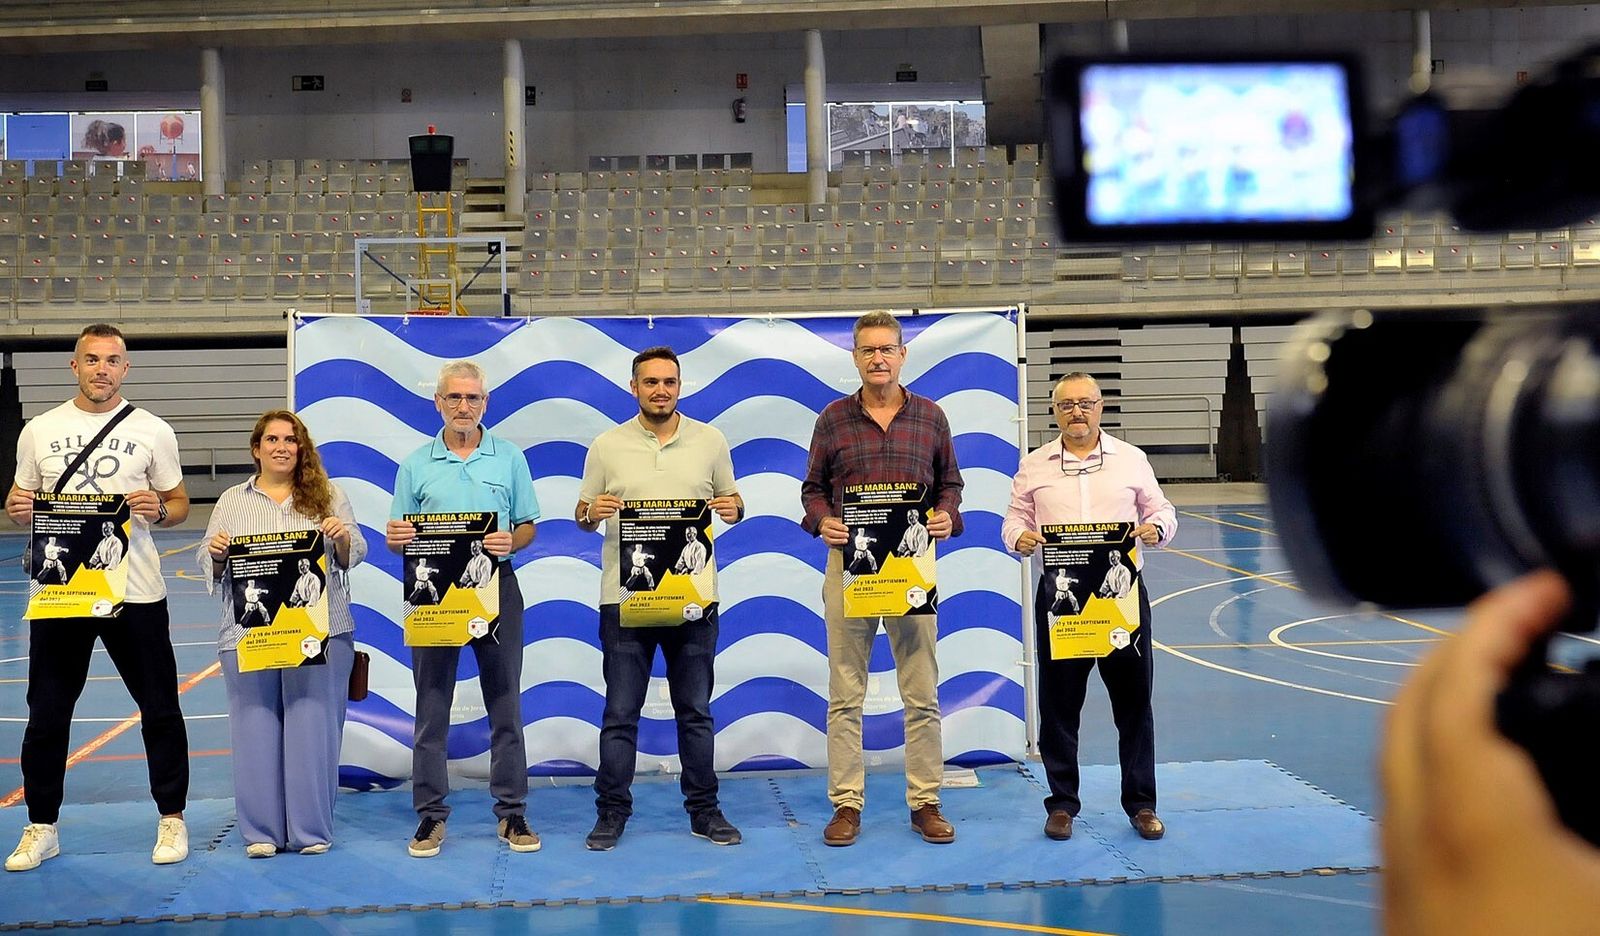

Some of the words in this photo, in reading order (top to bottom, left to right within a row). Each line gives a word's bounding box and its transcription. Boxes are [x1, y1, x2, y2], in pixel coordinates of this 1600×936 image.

[50, 435, 136, 455] SILON
[845, 484, 863, 494] LUIS
[864, 484, 893, 492] MARIA
[894, 482, 918, 490] SANZ
[36, 493, 56, 501] LUIS
[57, 494, 88, 502] MARIA
[622, 501, 642, 509] LUIS
[673, 500, 697, 508] SANZ
[405, 515, 425, 523] LUIS
[426, 514, 457, 522] MARIA
[458, 513, 483, 521] SANZ
[1044, 525, 1063, 533] LUIS
[1064, 524, 1095, 532] MARIA
[231, 536, 251, 545] LUIS
[252, 534, 282, 543] MARIA
[284, 531, 308, 540] SANZ
